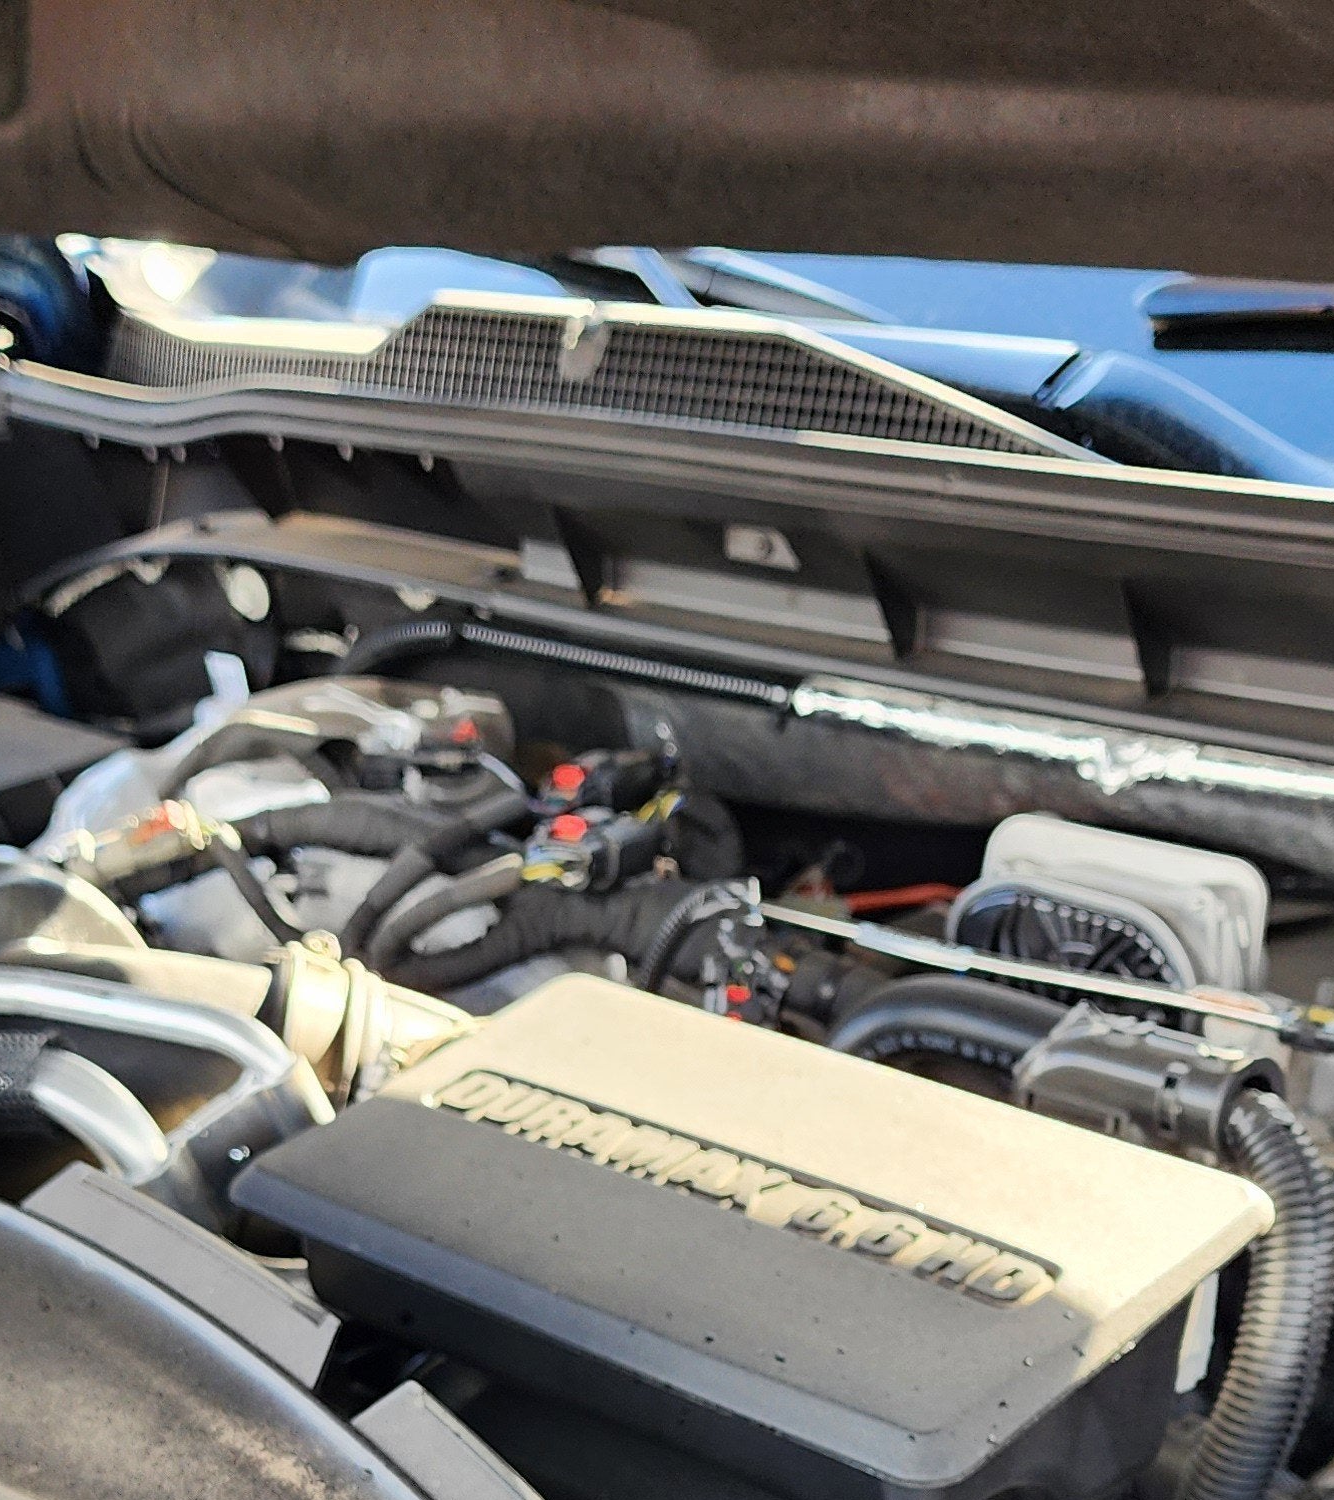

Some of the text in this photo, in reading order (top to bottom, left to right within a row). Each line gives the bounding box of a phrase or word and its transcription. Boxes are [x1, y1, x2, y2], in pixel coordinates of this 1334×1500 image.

[435, 1073, 1053, 1304] DURAMAX 6.6 HD
